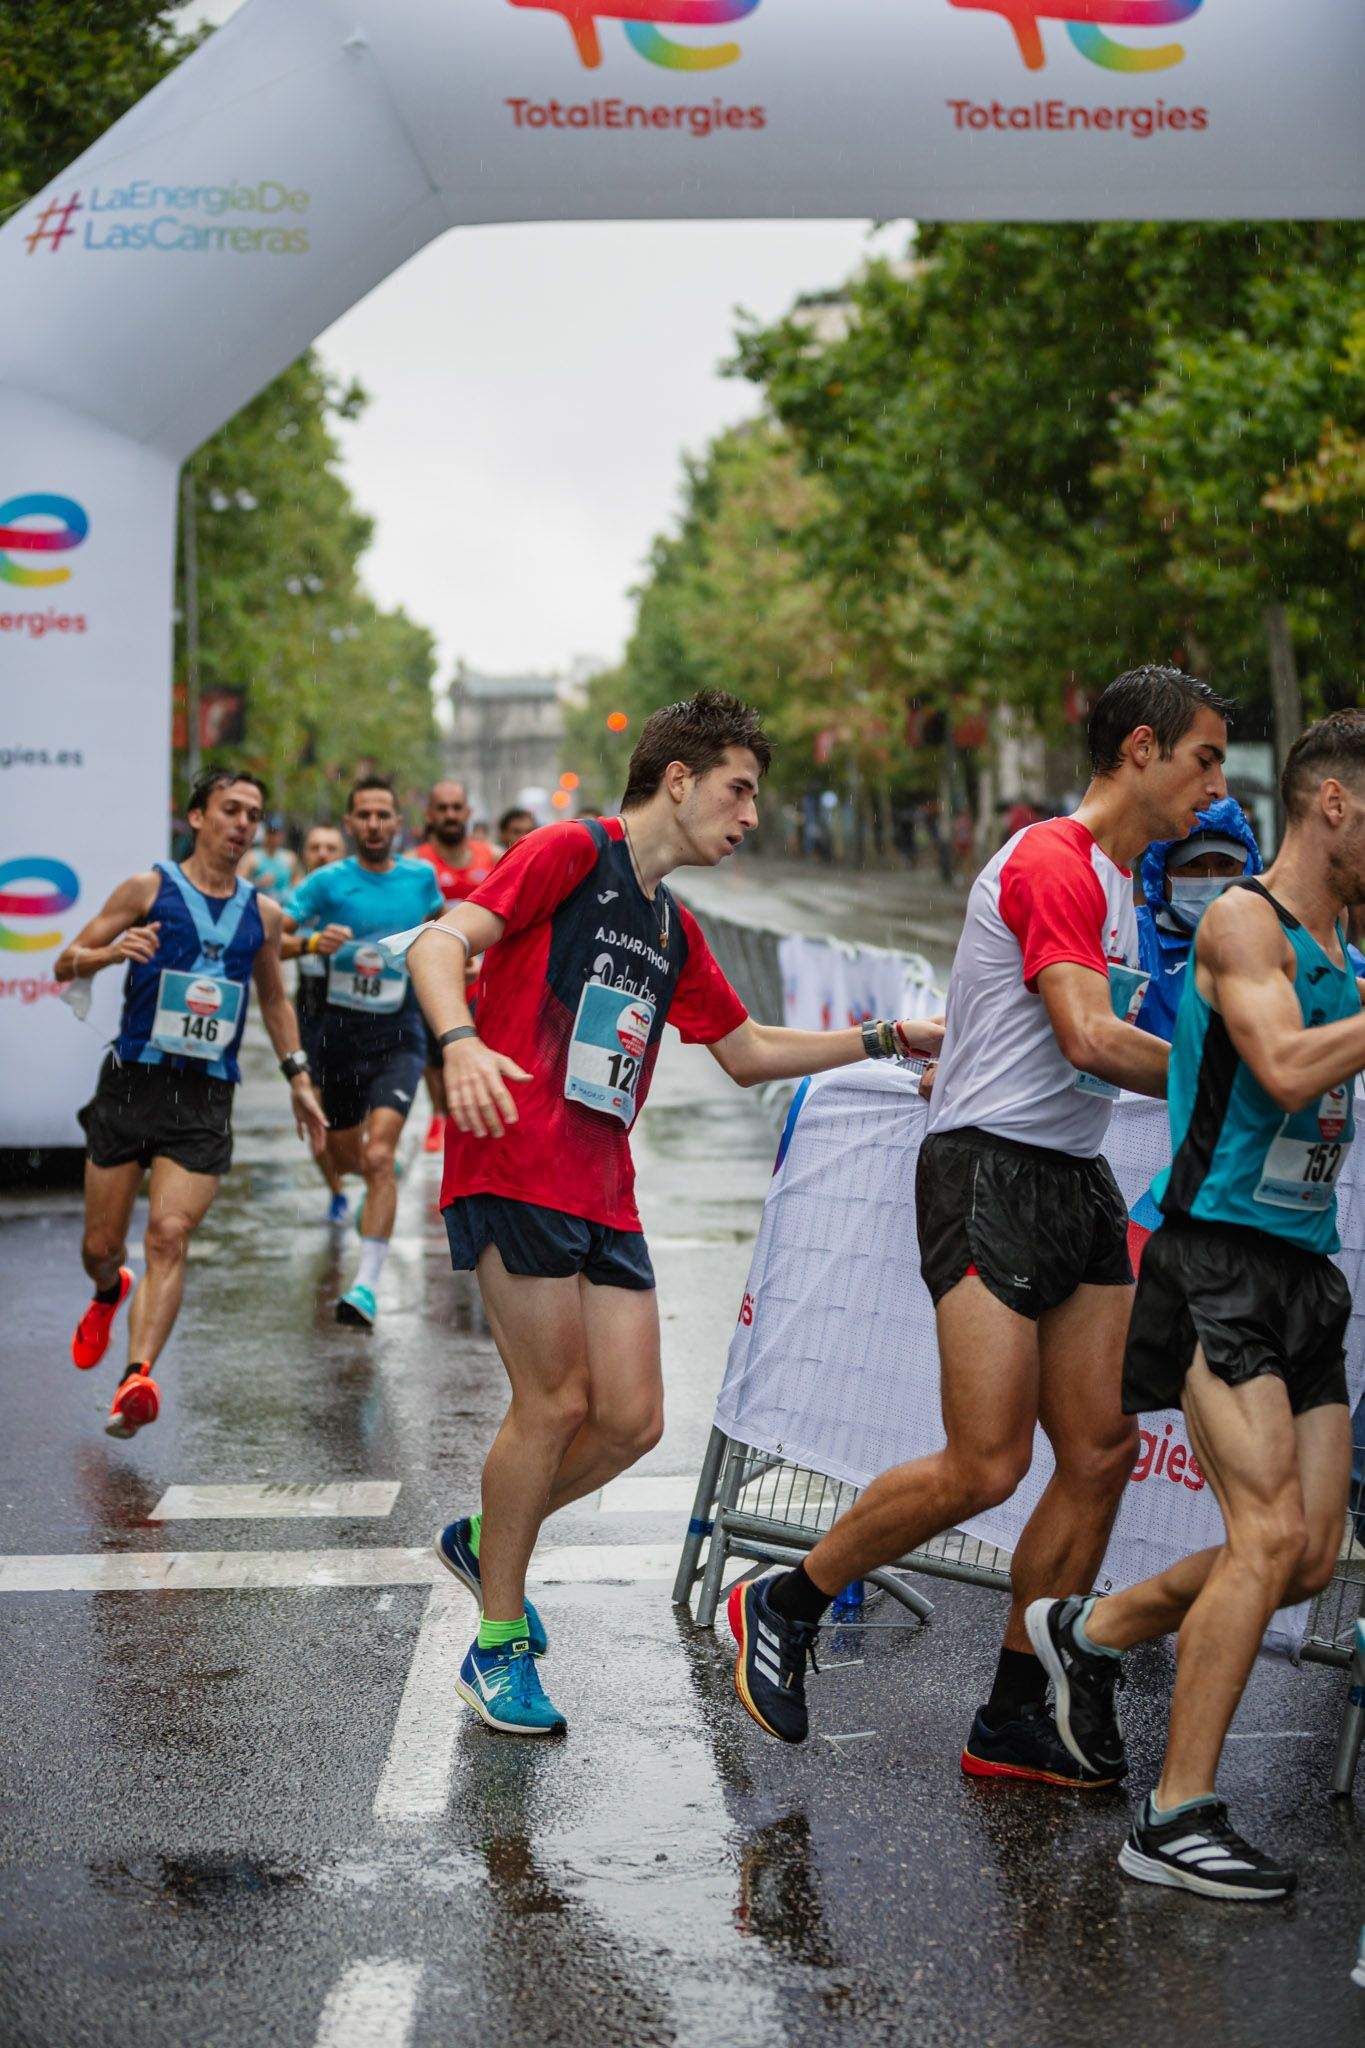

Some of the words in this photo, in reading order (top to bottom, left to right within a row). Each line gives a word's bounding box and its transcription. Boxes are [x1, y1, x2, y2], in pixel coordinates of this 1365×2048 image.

[504, 97, 767, 137] TotalEnergies
[946, 98, 1208, 138] TotalEnergies
[84, 215, 310, 254] LasCarreras
[181, 1015, 219, 1042] 146
[1302, 1143, 1341, 1183] 152
